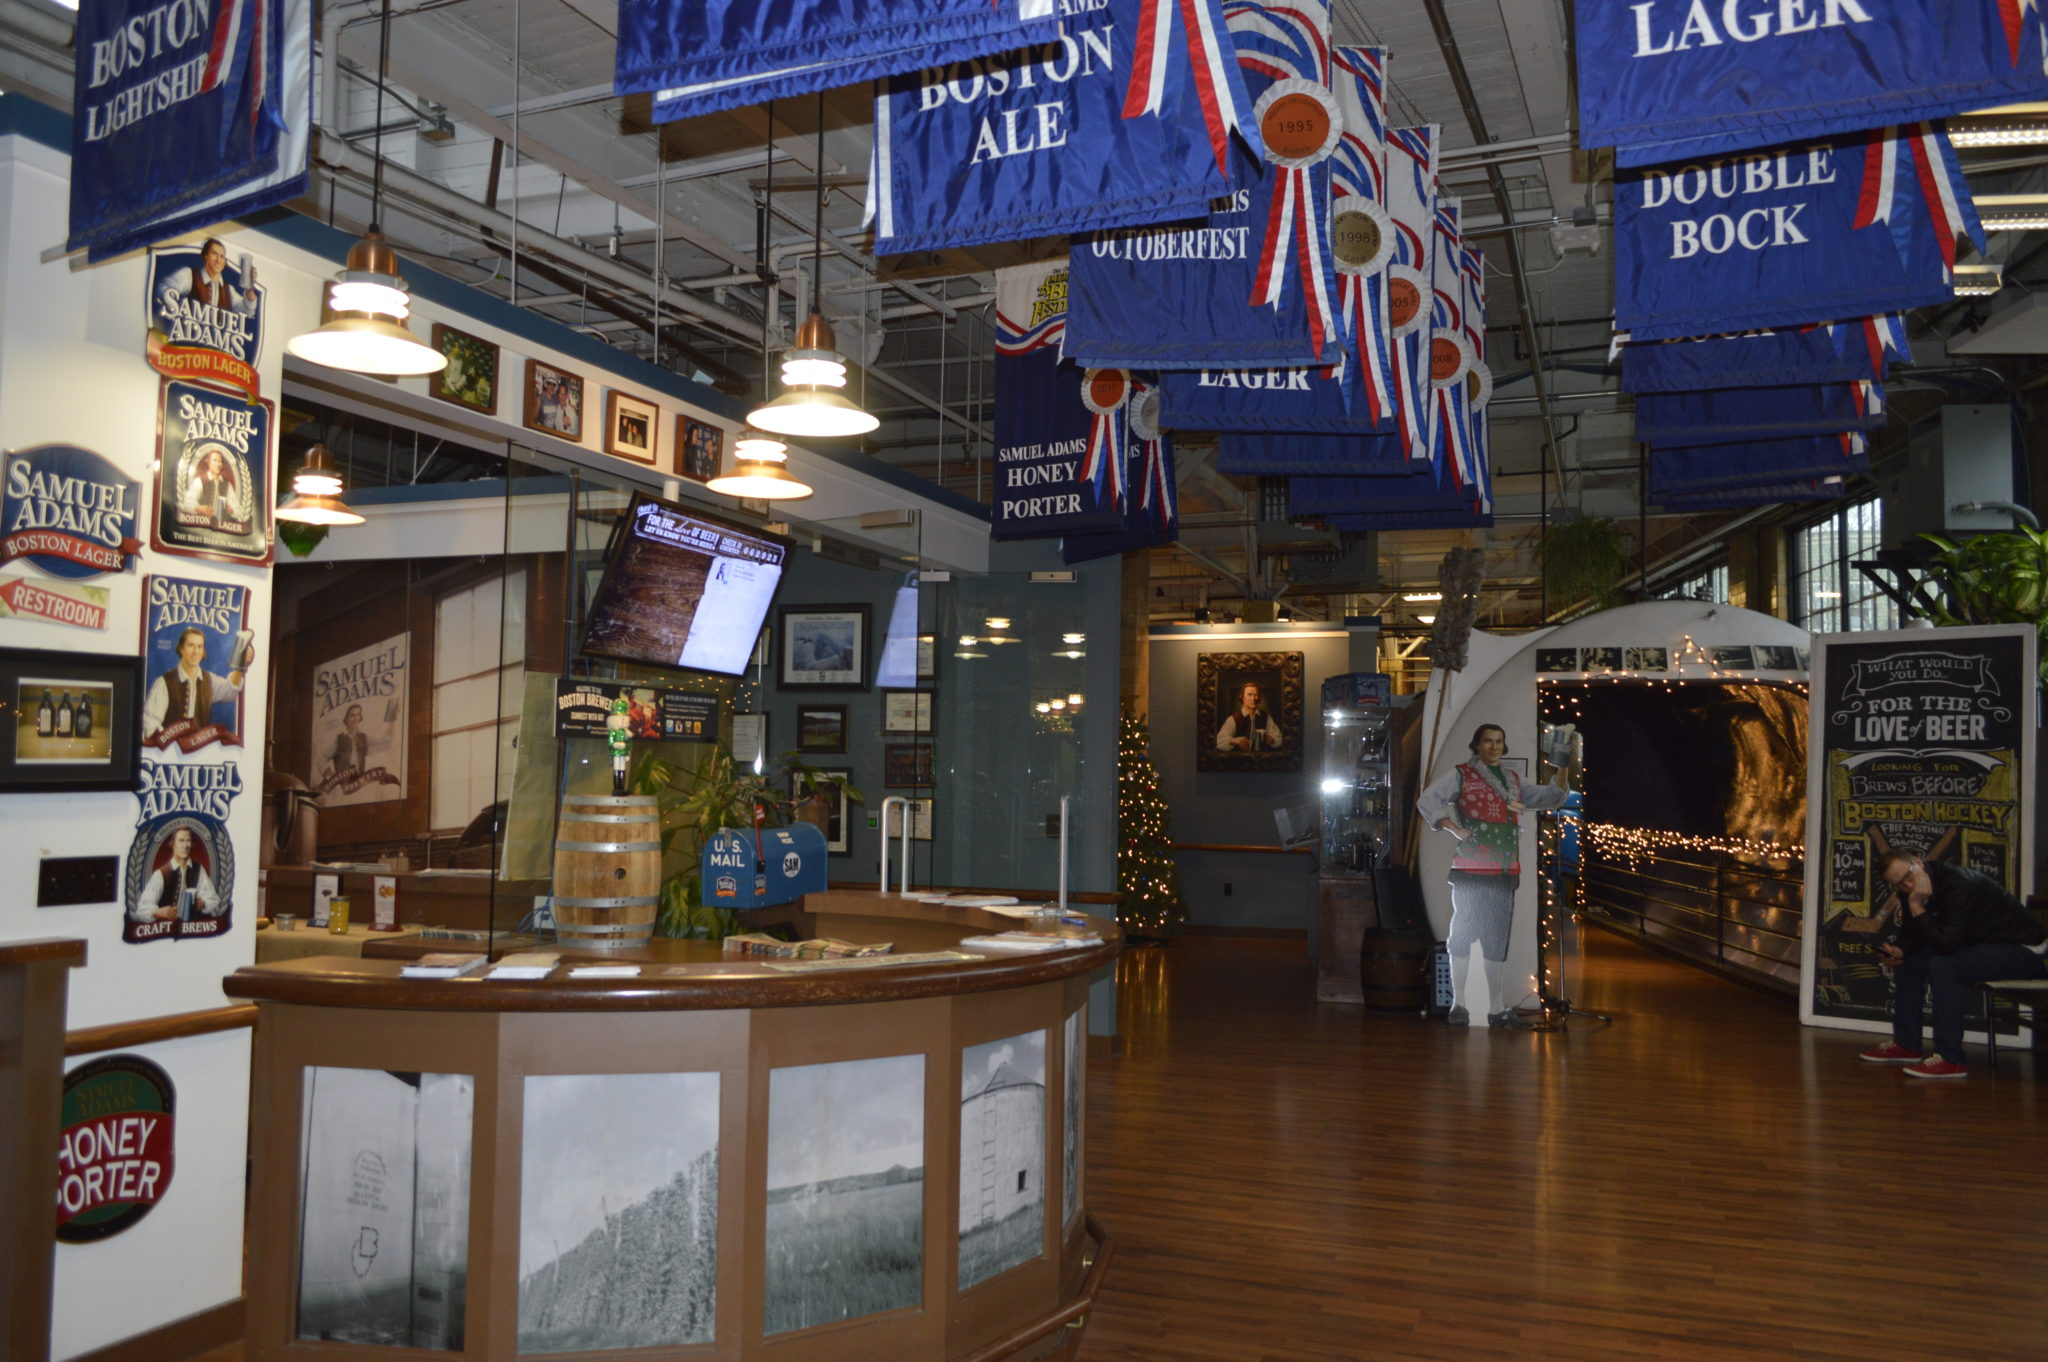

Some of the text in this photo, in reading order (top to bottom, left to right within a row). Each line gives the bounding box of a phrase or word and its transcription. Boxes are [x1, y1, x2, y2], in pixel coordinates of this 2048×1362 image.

[89, 0, 210, 89] BOSTON
[918, 25, 1114, 112] BOSTON
[85, 52, 208, 142] LIGHTSHIP
[970, 101, 1067, 165] ALE
[1279, 121, 1313, 134] 1995
[1640, 144, 1837, 210] DOUBLE
[1092, 226, 1250, 262] OCTOBERFEST
[1339, 231, 1371, 244] 1998
[1670, 203, 1810, 260] BOCK
[159, 288, 253, 341] SAMUEL
[168, 318, 245, 361] ADAMS
[158, 351, 251, 383] BOSTON LAGER
[1197, 368, 1312, 391] LAGER
[179, 394, 258, 436] SAMUEL
[184, 419, 249, 454] ADAMS
[999, 438, 1087, 463] SAMUEL ADAMS
[1007, 461, 1078, 487] HONEY
[8, 459, 134, 520] SAMUEL
[1002, 493, 1083, 520] PORTER
[12, 497, 123, 547] ADAMS
[180, 512, 243, 532] BOSTON LAGER
[647, 514, 661, 526] FOR
[661, 517, 676, 530] THE
[6, 535, 124, 569] BOSTON LAGER
[13, 585, 100, 629] RESTROOM
[151, 577, 240, 613] SAMUEL
[154, 604, 230, 635] ADAMS
[315, 646, 405, 698] SAMUEL
[1868, 658, 1973, 673] WHAT WOULD
[320, 671, 396, 718] ADAMS
[558, 693, 586, 710] BOSTON
[1868, 695, 1972, 714] FOR THE
[160, 720, 218, 746] BOSTON LAGER
[1854, 715, 1986, 742] LOVE of BEER
[140, 759, 242, 794] SAMUEL
[1871, 762, 1960, 772] LOOKING FOR
[137, 789, 230, 827] ADAMS
[1845, 801, 2011, 831] BOSTON HOCKEY
[1880, 823, 1946, 835] FREE TASTING
[1837, 842, 1861, 851] TOUR
[1889, 838, 1931, 850] SHUTTLE
[710, 854, 745, 867] MAIL
[784, 858, 800, 872] SAM
[1834, 853, 1865, 868] 10 AM
[1834, 878, 1857, 892] 1 PM
[136, 920, 218, 937] CRAFT BREWS
[1839, 943, 1863, 953] FREE
